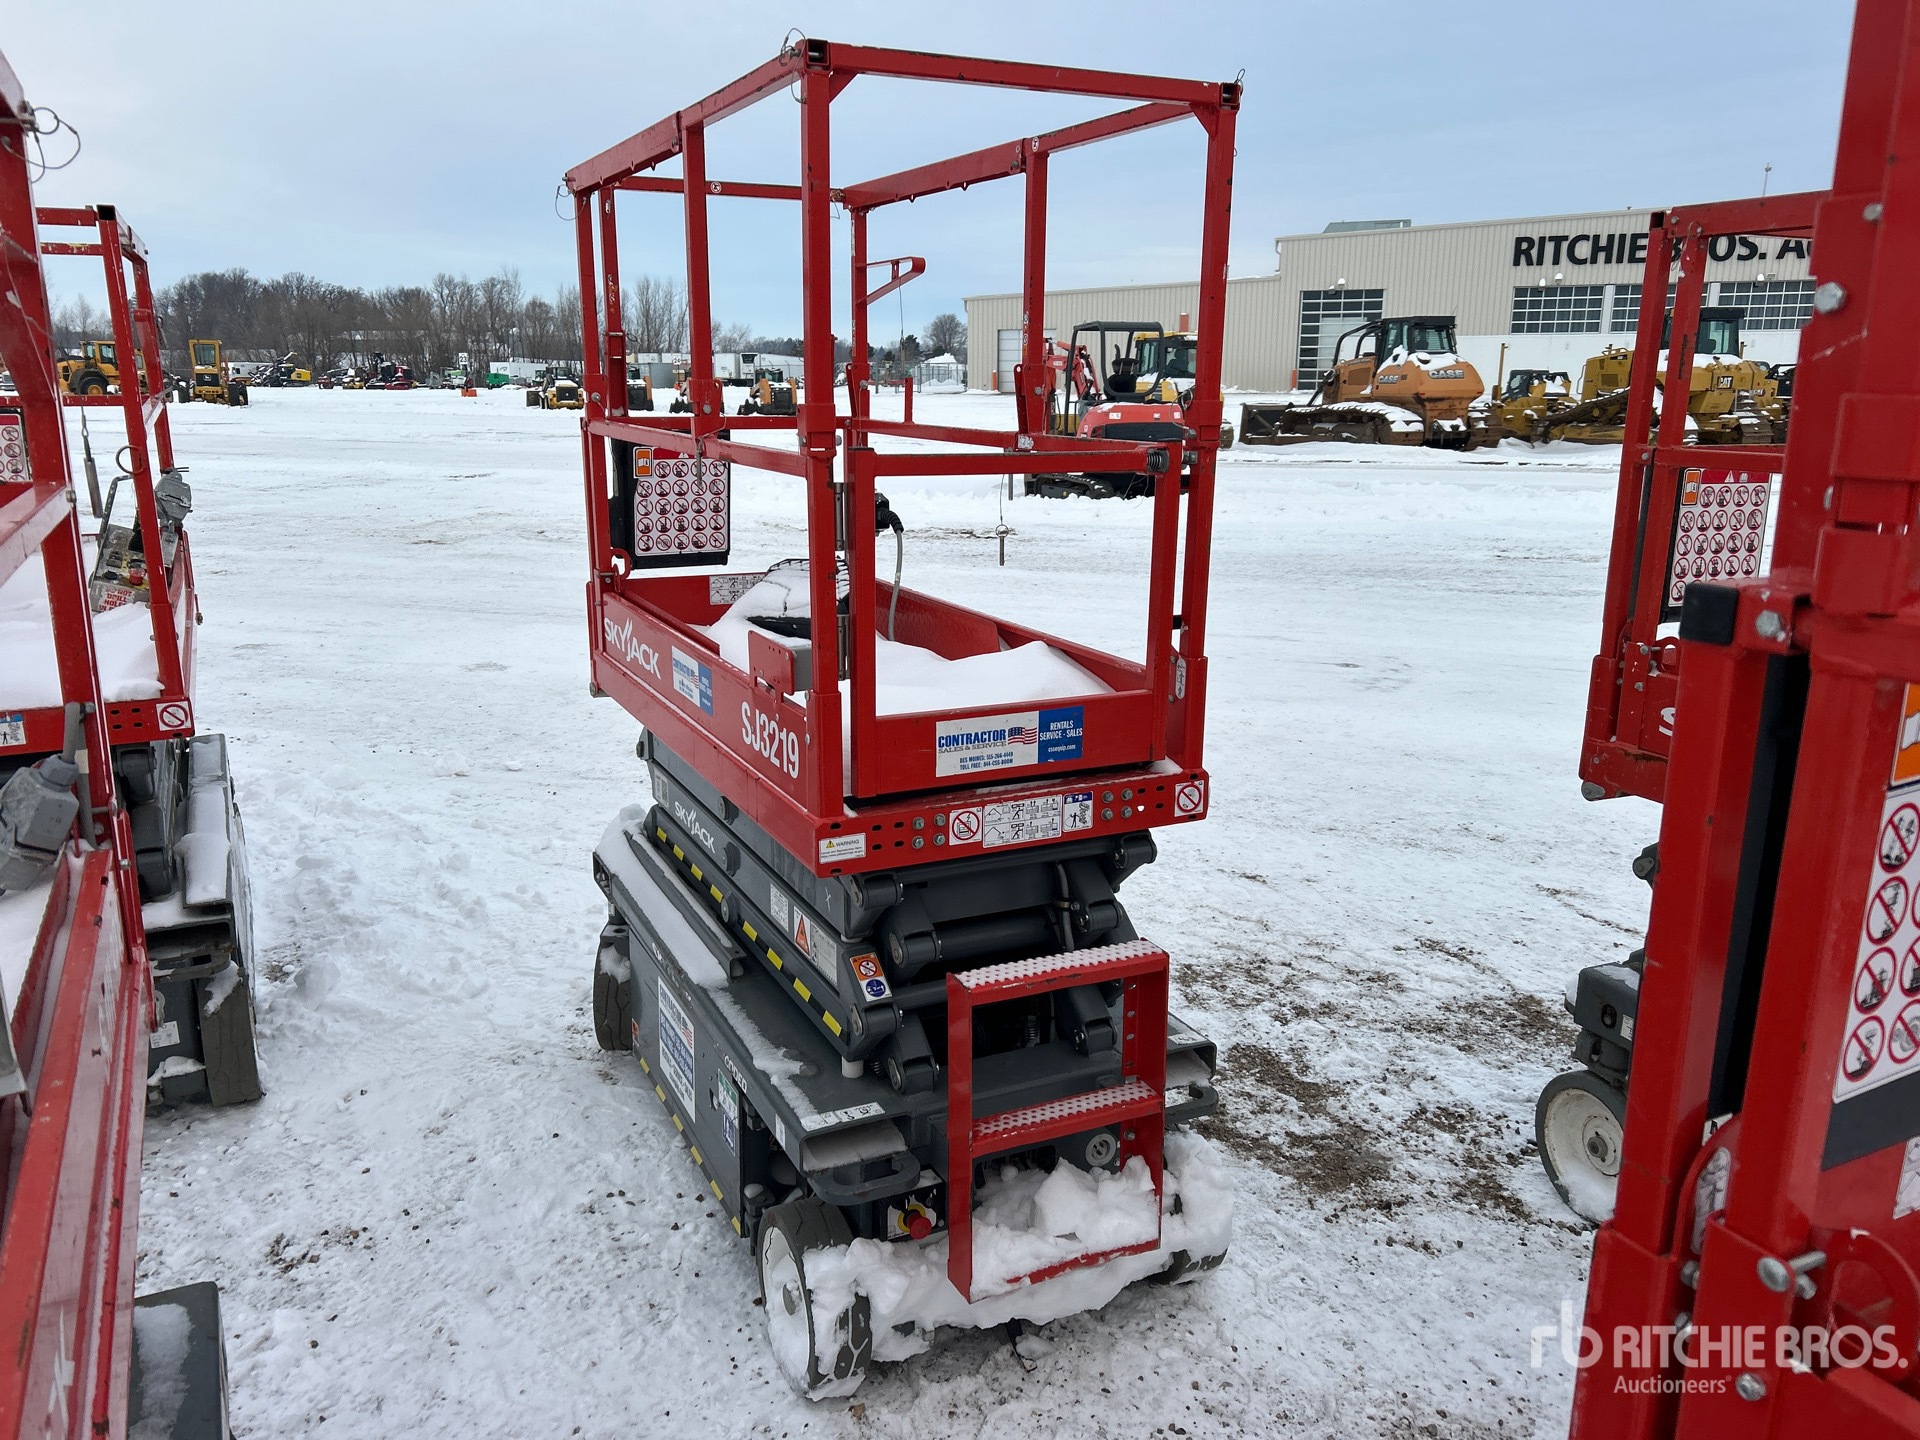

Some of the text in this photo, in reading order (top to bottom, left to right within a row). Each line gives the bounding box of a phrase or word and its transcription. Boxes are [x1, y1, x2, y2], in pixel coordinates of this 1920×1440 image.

[1513, 232, 1649, 266] RITCHIE
[1378, 375, 1399, 384] CASE
[1429, 369, 1465, 379] CASE
[1719, 377, 1732, 388] CAT
[604, 617, 661, 680] SKYJACK
[1050, 720, 1074, 731] RENTALS
[741, 701, 799, 779] SJ3219
[938, 728, 1006, 748] CONTRACTOR
[1040, 731, 1062, 741] SERVICE
[1067, 727, 1083, 738] SALES
[938, 745, 963, 754] SALES
[972, 741, 1006, 750] SERVICE
[675, 801, 715, 854] SKYJACK
[836, 839, 860, 847] WARNING
